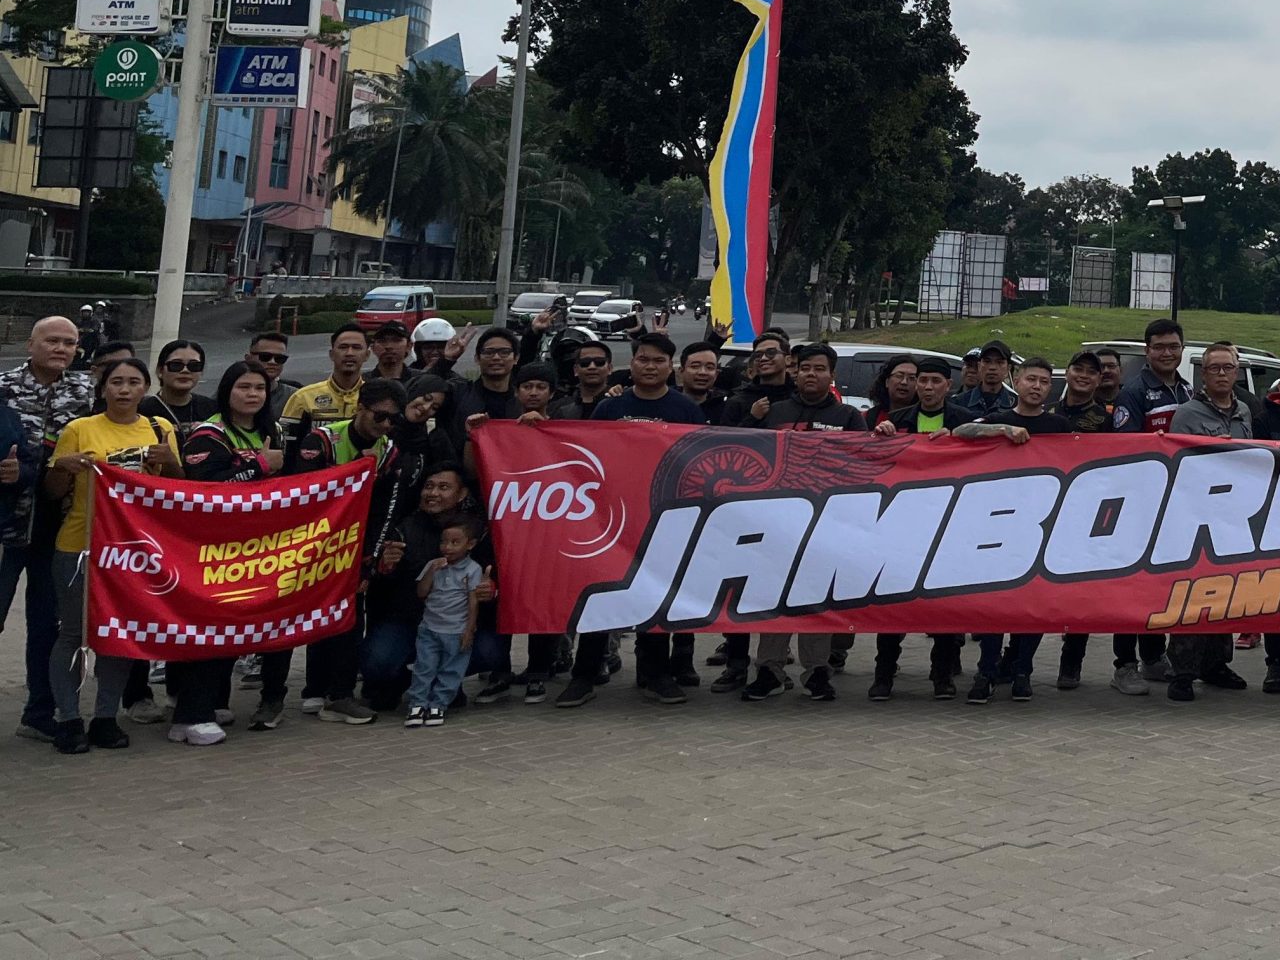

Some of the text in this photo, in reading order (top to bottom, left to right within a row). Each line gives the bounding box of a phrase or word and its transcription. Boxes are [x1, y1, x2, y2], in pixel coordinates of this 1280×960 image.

[108, 0, 135, 9] ATM
[234, 5, 260, 16] atm
[247, 55, 289, 70] ATM
[259, 72, 296, 87] BCA
[488, 480, 600, 521] IMOS
[198, 517, 331, 563] INDONESIA
[202, 521, 361, 586] MOTORCYCLE
[98, 545, 163, 575] IMOS
[276, 542, 360, 599] SHOW
